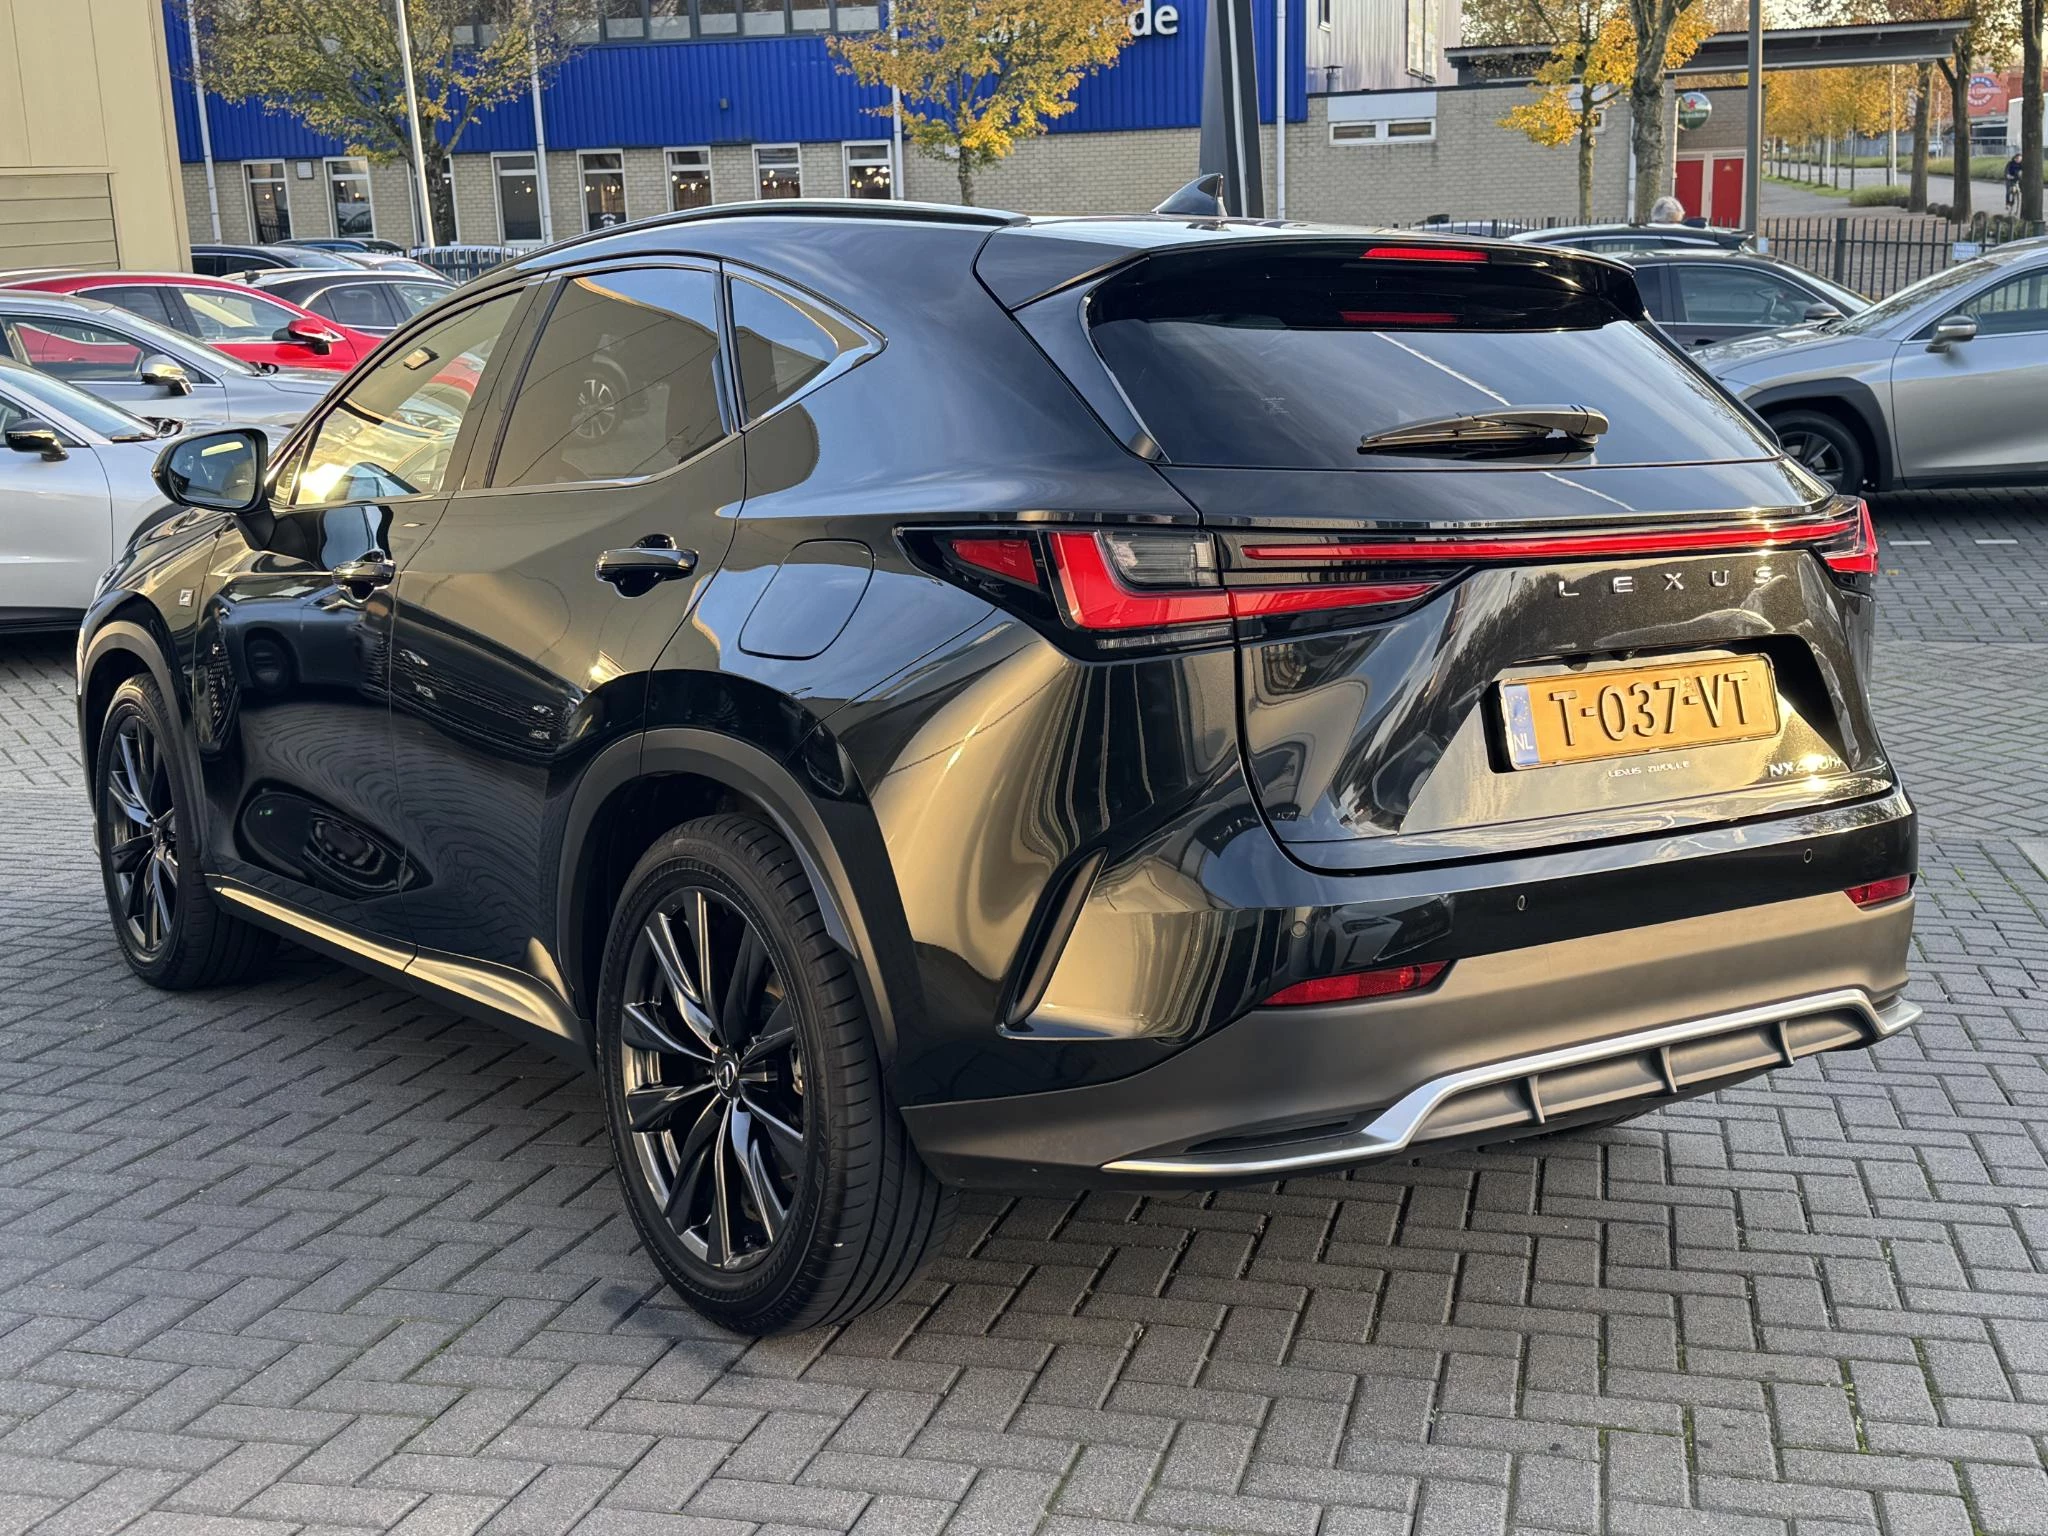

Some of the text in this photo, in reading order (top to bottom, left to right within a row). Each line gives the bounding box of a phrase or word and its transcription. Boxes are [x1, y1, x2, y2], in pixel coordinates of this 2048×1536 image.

[1558, 566, 1772, 598] LEXUS
[1548, 671, 1749, 747] T-037-VT
[1514, 732, 1534, 751] NL
[1608, 766, 1642, 778] LEXUS
[1769, 760, 1793, 777] NX
